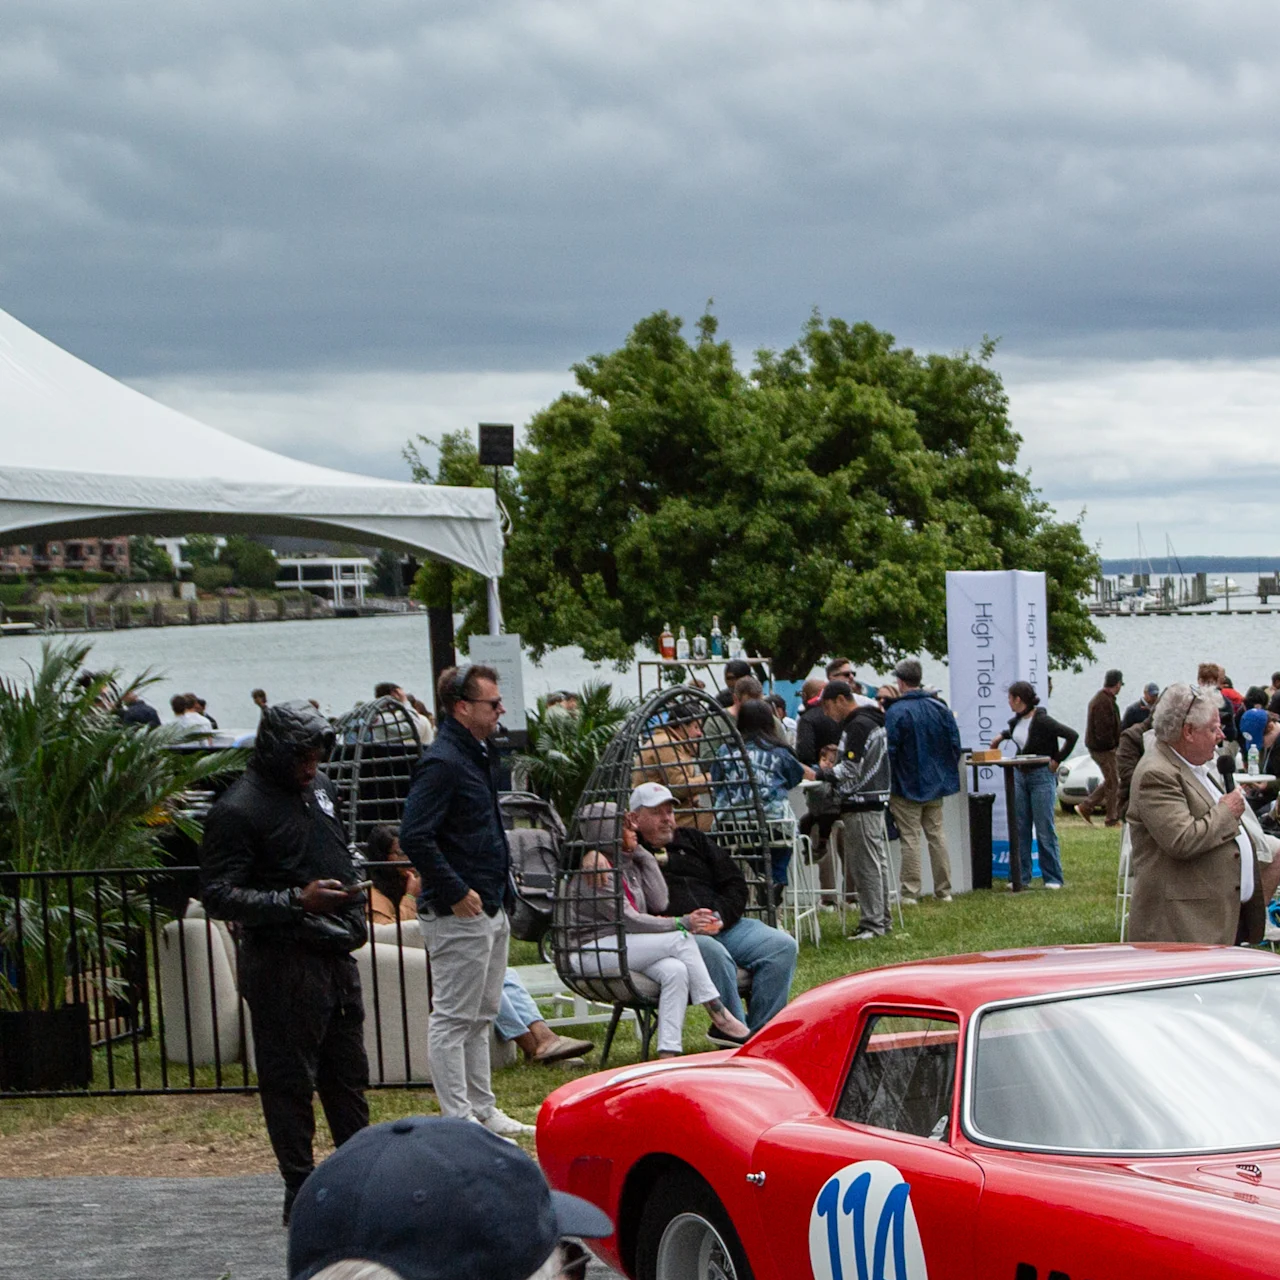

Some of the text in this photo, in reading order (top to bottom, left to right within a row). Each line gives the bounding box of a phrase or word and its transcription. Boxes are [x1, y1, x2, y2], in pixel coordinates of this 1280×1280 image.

[1026, 603, 1037, 648] High
[971, 603, 995, 779] High Tide Loue
